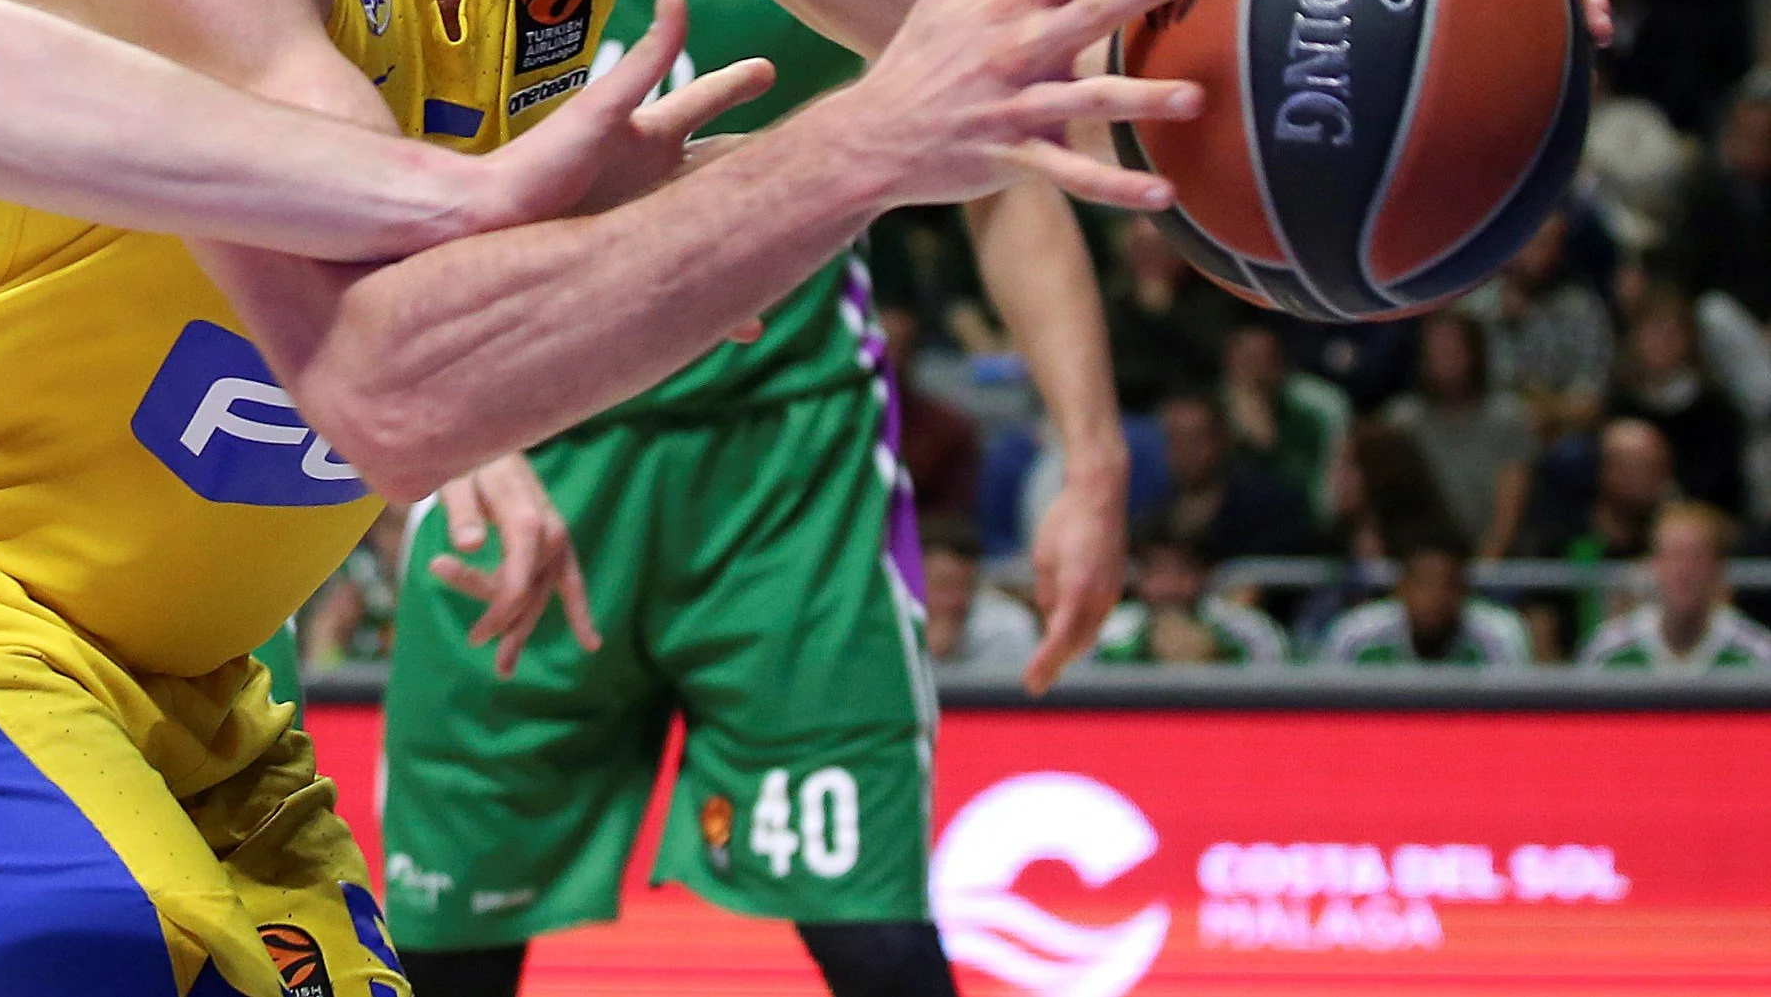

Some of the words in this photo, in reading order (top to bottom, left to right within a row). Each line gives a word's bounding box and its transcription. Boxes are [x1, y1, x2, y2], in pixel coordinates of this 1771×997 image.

[525, 31, 581, 57] AIRLINES
[526, 18, 584, 44] TURKISH
[508, 67, 589, 116] oneteam
[750, 766, 860, 879] 40
[1198, 842, 1389, 897] COSTA
[1391, 844, 1509, 899] DEL
[1509, 844, 1630, 900] SOL
